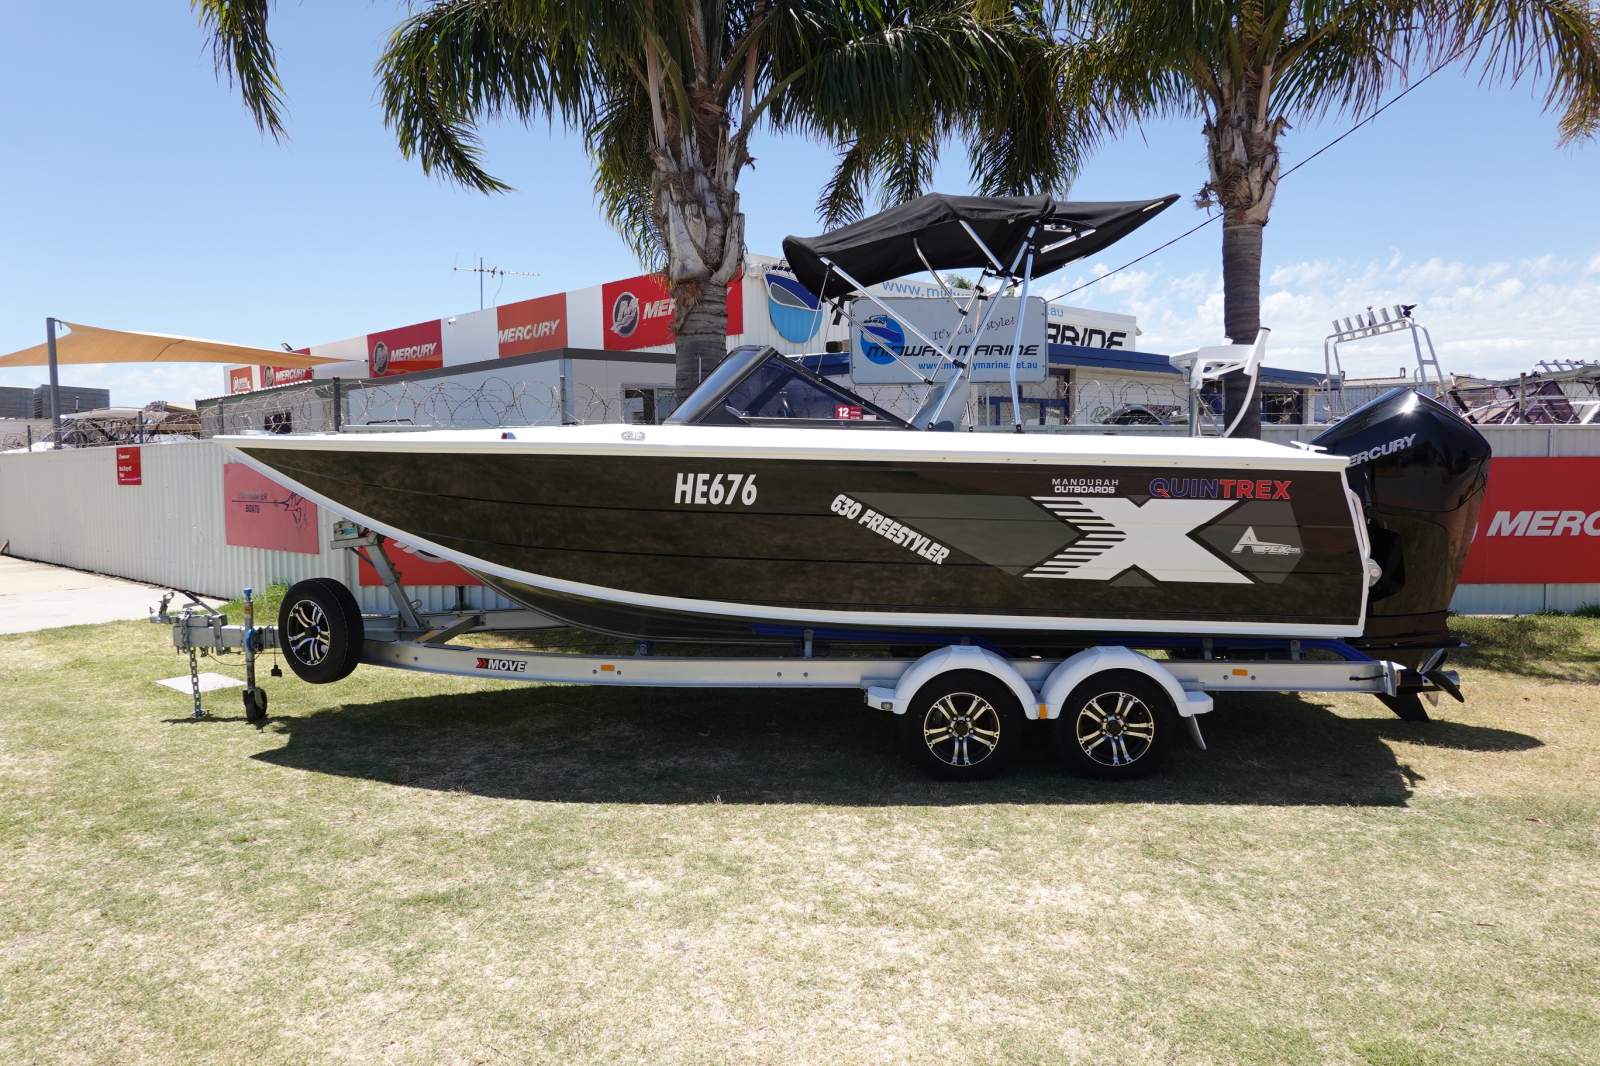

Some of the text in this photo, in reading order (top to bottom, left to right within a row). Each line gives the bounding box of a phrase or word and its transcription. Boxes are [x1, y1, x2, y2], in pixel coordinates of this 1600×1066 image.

[498, 319, 561, 344] MERCURY
[1048, 323, 1127, 349] ARINE
[390, 342, 438, 362] MERCURY
[838, 407, 849, 417] 12
[1345, 433, 1417, 468] ERCURY
[674, 472, 758, 506] HE676
[1051, 478, 1119, 486] MANDURAH
[1054, 485, 1116, 494] OUTBOARDS
[1150, 478, 1292, 499] QUINTREX
[830, 493, 951, 565] 630 FREESTYLER
[488, 659, 526, 672] MOVE
